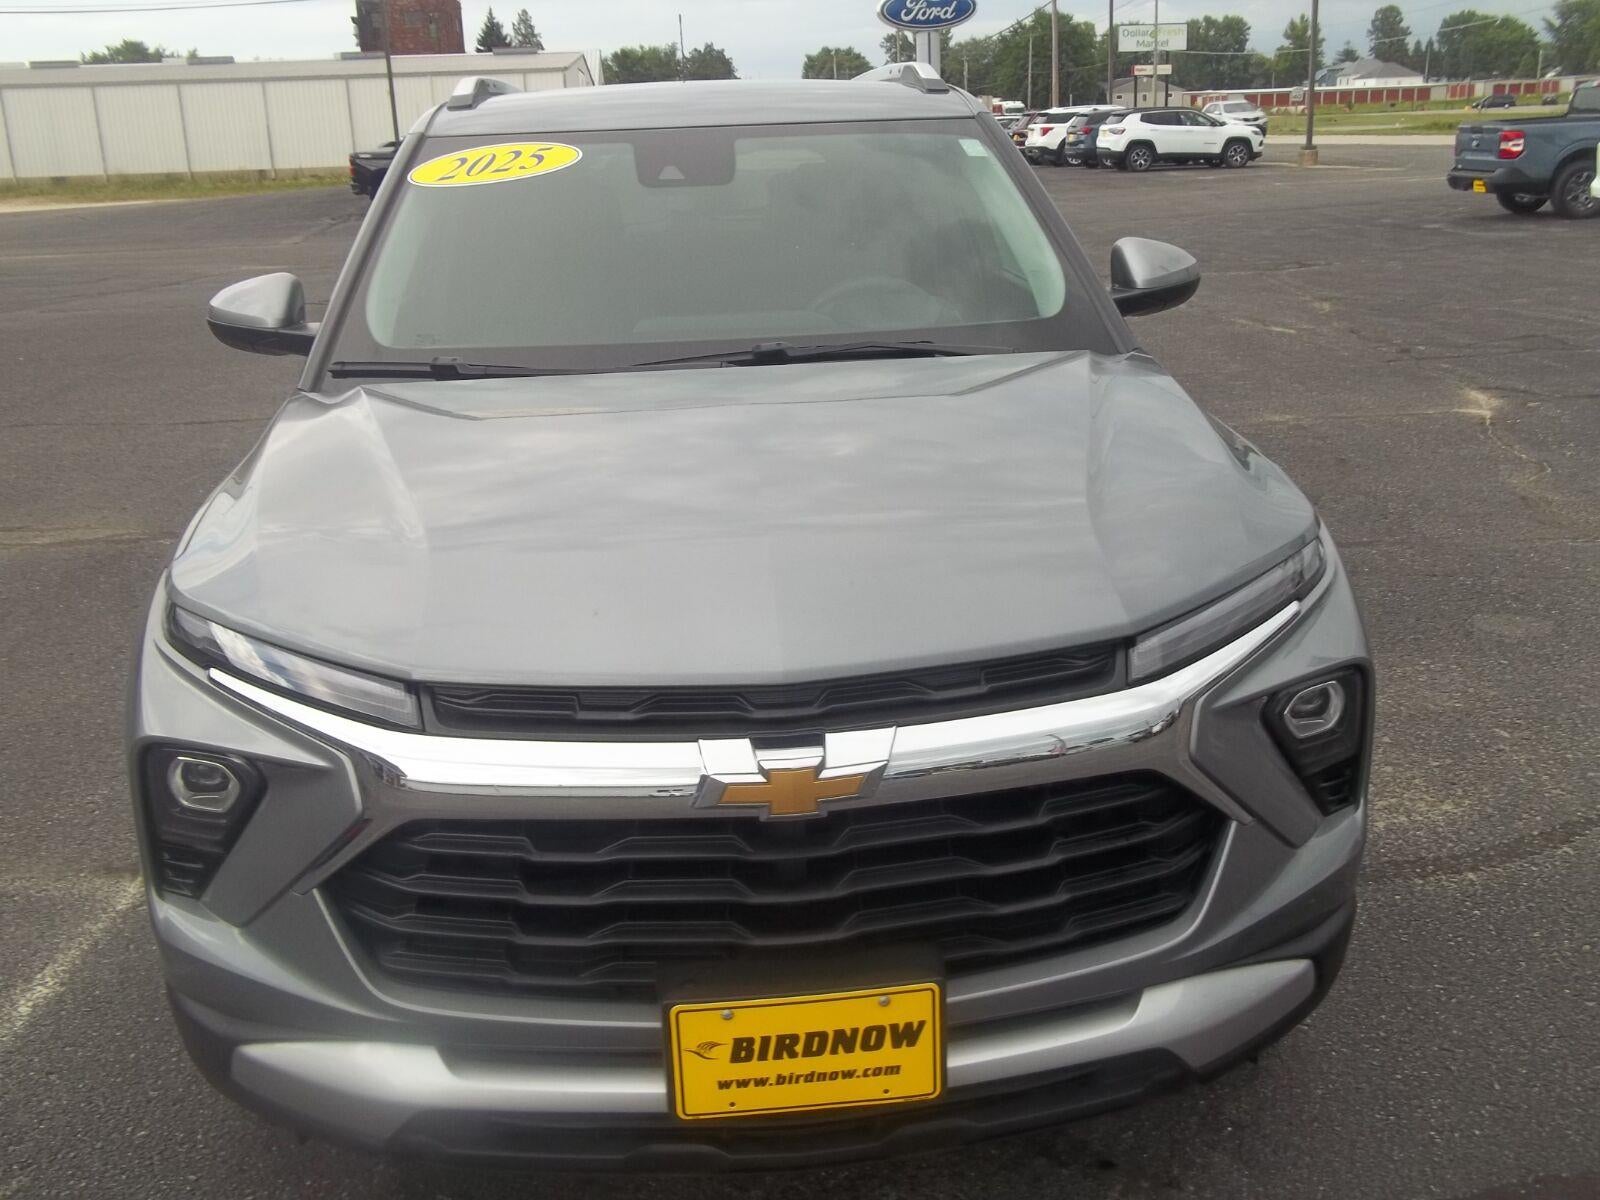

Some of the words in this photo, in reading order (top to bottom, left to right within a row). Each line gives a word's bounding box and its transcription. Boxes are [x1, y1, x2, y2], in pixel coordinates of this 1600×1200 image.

[901, 0, 957, 21] Ford
[434, 147, 553, 181] 2025
[729, 1019, 927, 1064] BIRDNOW
[717, 1064, 901, 1091] www.birdnow.com
